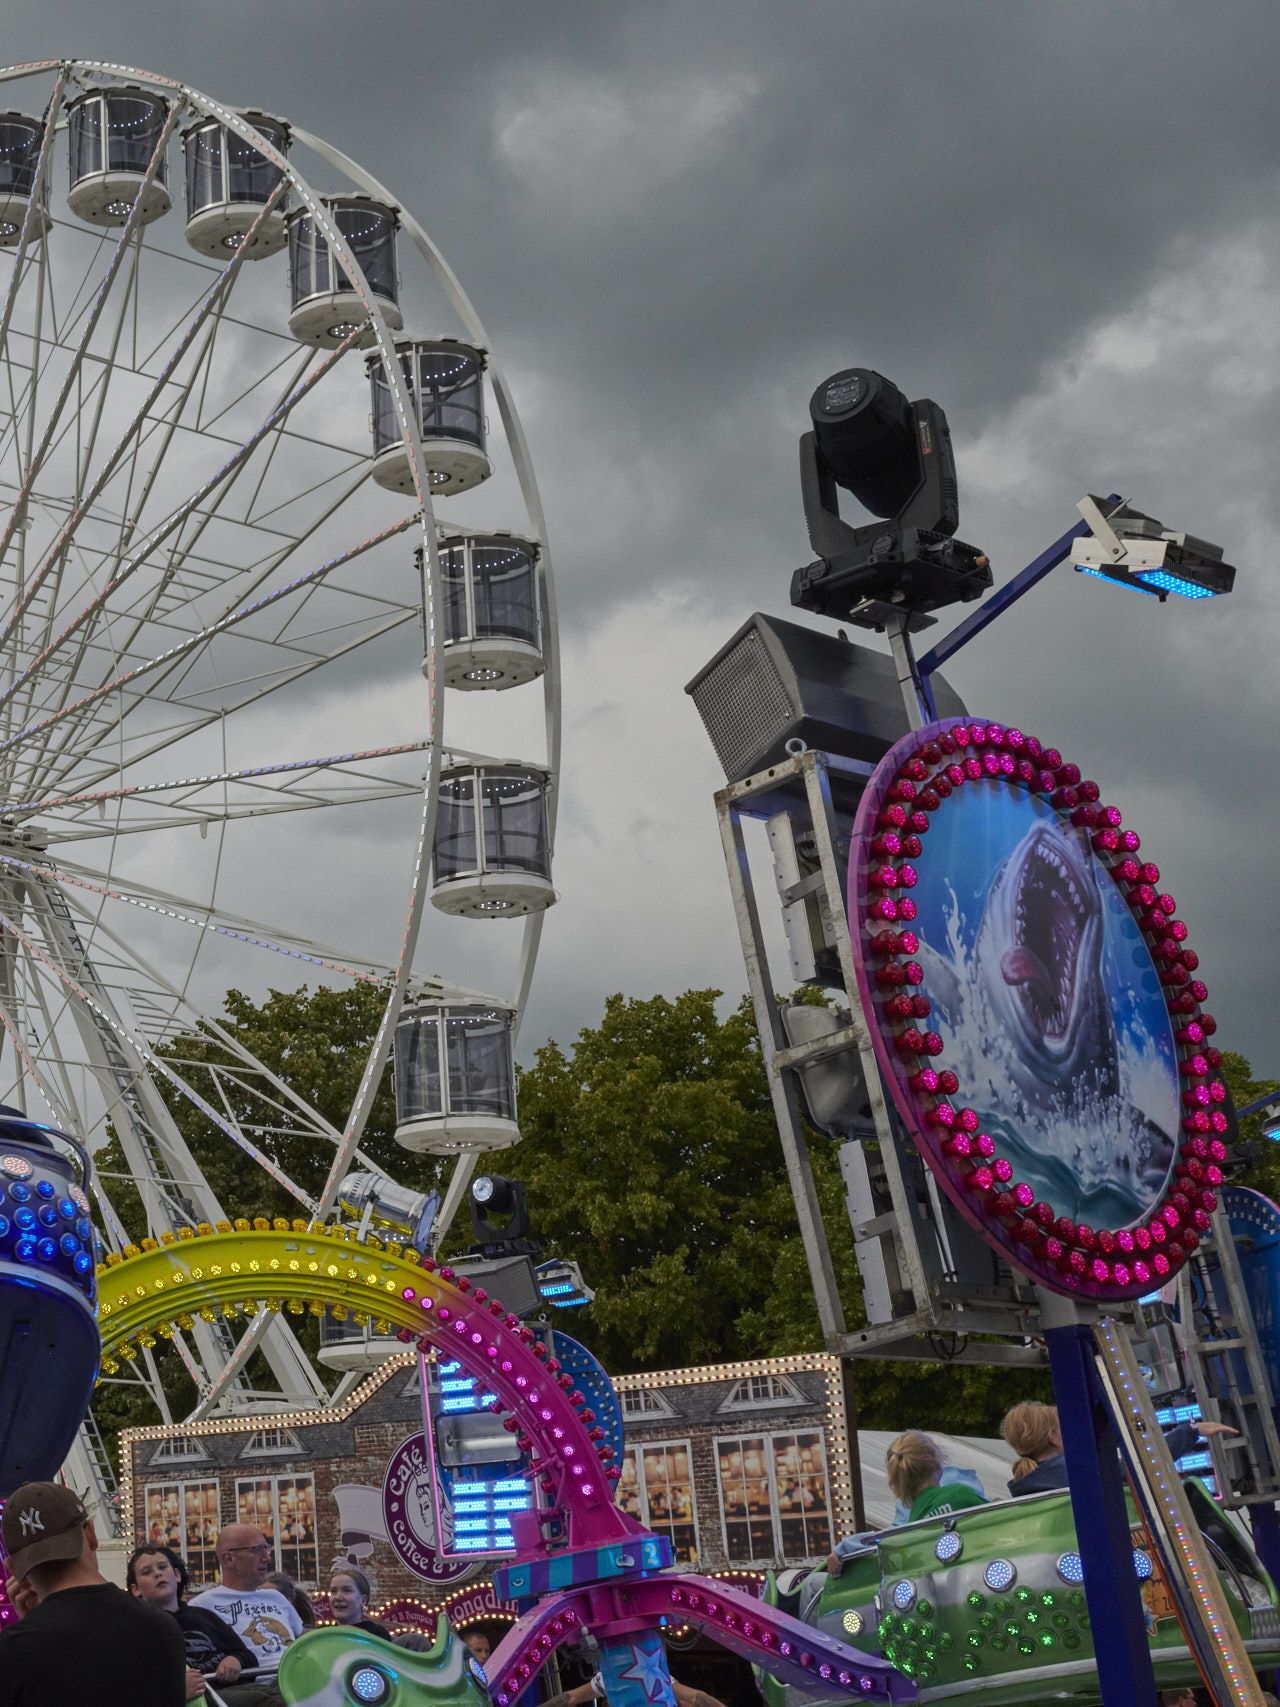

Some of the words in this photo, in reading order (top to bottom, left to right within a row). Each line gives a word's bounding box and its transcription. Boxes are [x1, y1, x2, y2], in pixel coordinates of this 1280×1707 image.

[390, 1445, 423, 1496] Café
[19, 1507, 46, 1537] NY
[393, 1519, 428, 1570] Coffee
[644, 1543, 659, 1566] 2
[447, 1588, 518, 1626] Longdrin
